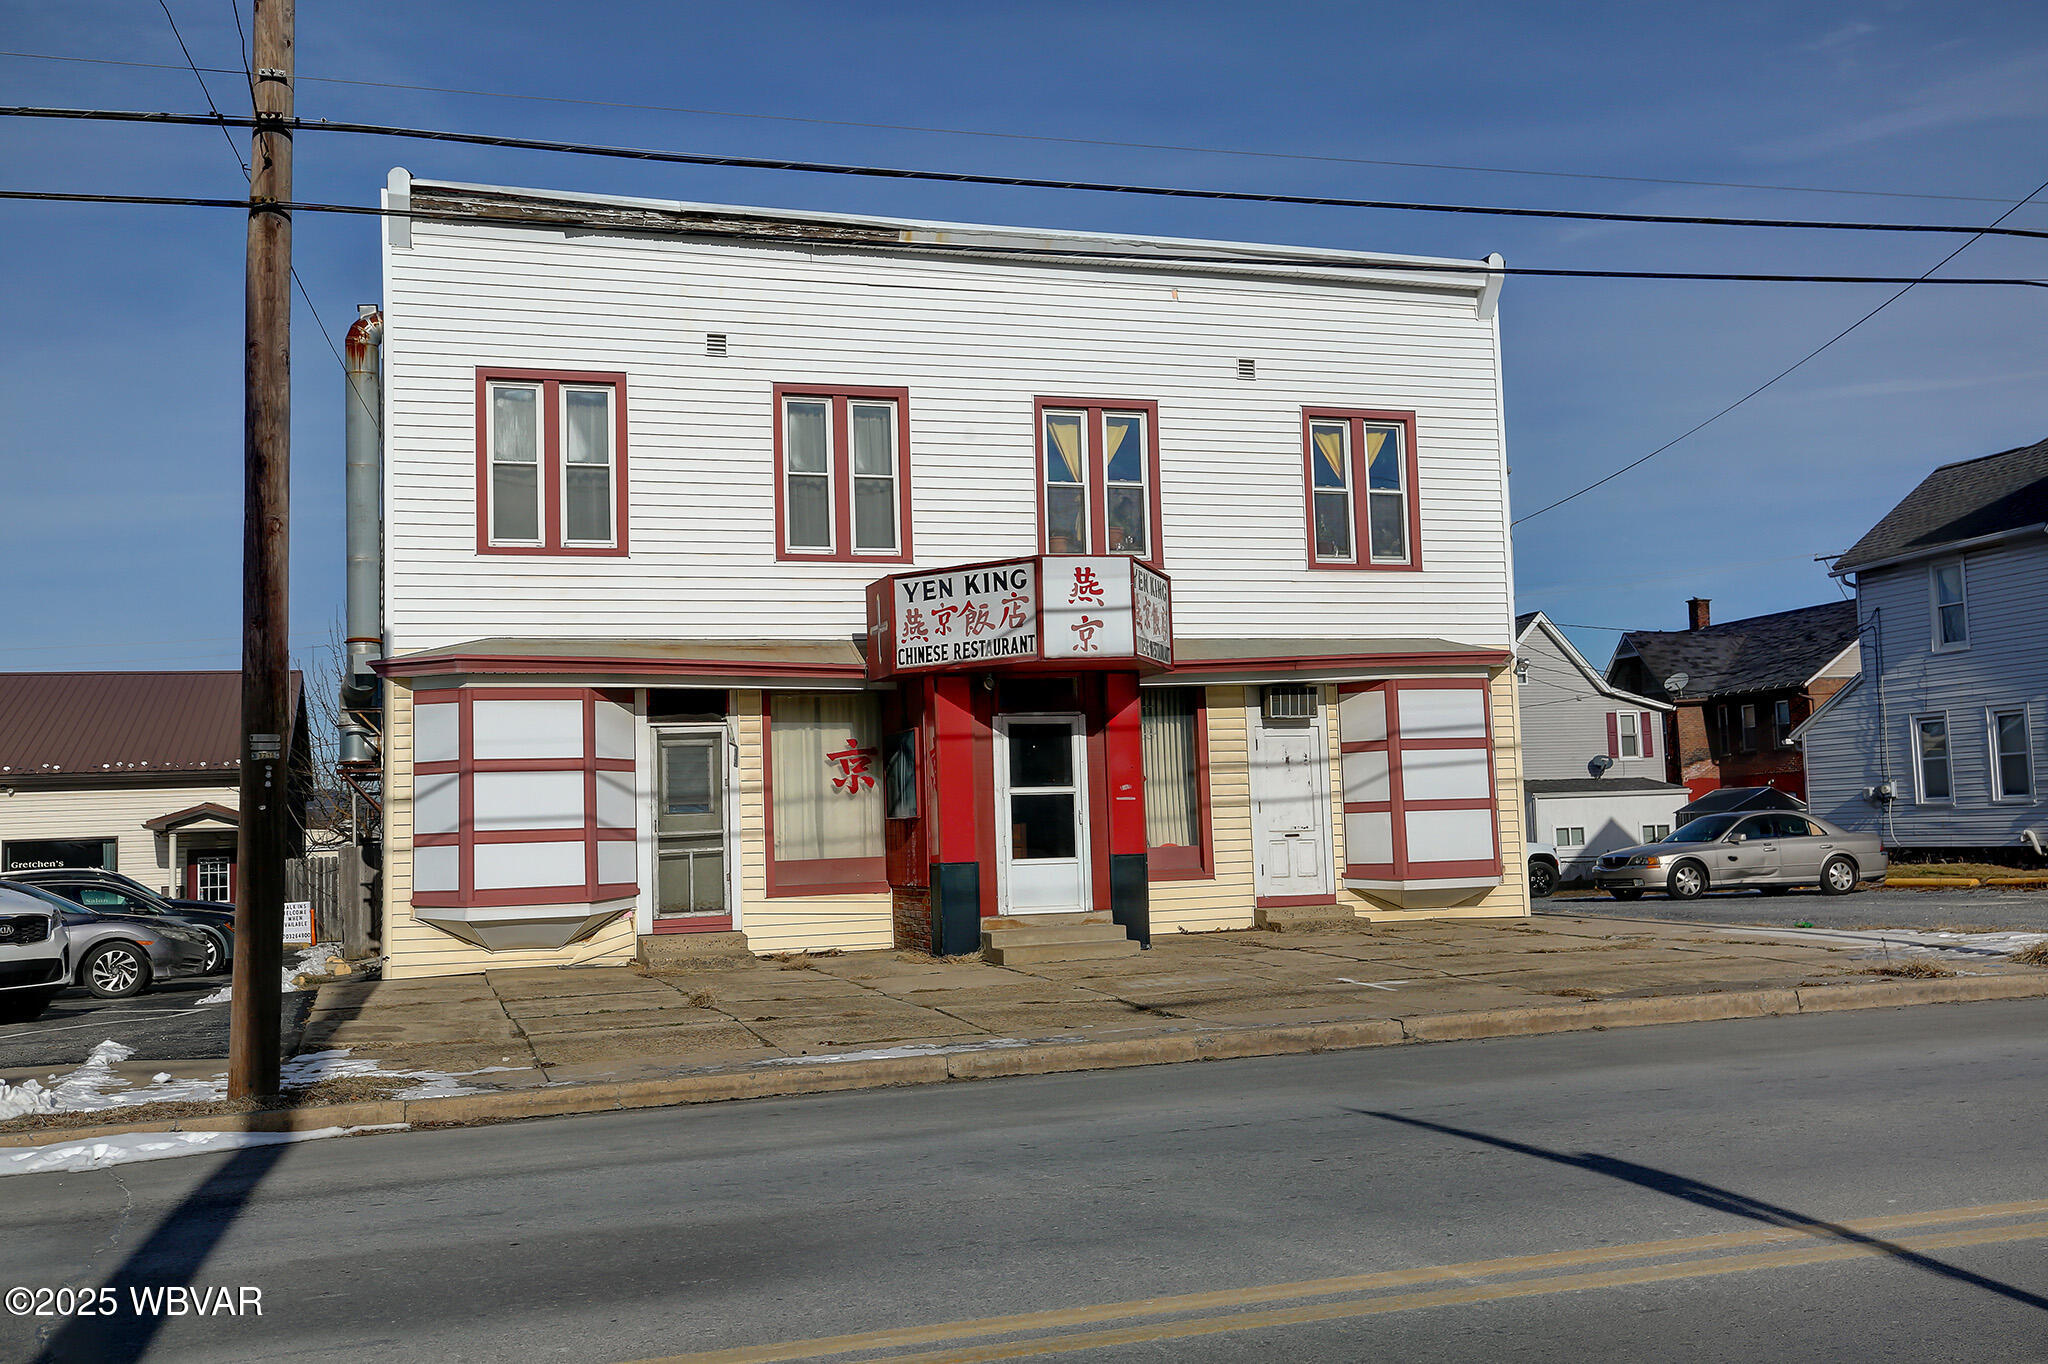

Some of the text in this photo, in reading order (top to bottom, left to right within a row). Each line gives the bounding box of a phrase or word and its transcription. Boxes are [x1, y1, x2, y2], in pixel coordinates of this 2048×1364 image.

[902, 569, 1028, 603] YEN KING
[1150, 575, 1167, 601] KING
[901, 591, 1030, 644] 燕京飯店
[1068, 566, 1104, 652] 燕京
[898, 634, 1035, 666] CHINESE RESTAURANT
[826, 738, 879, 794] 京
[11, 860, 65, 869] Gretchen's
